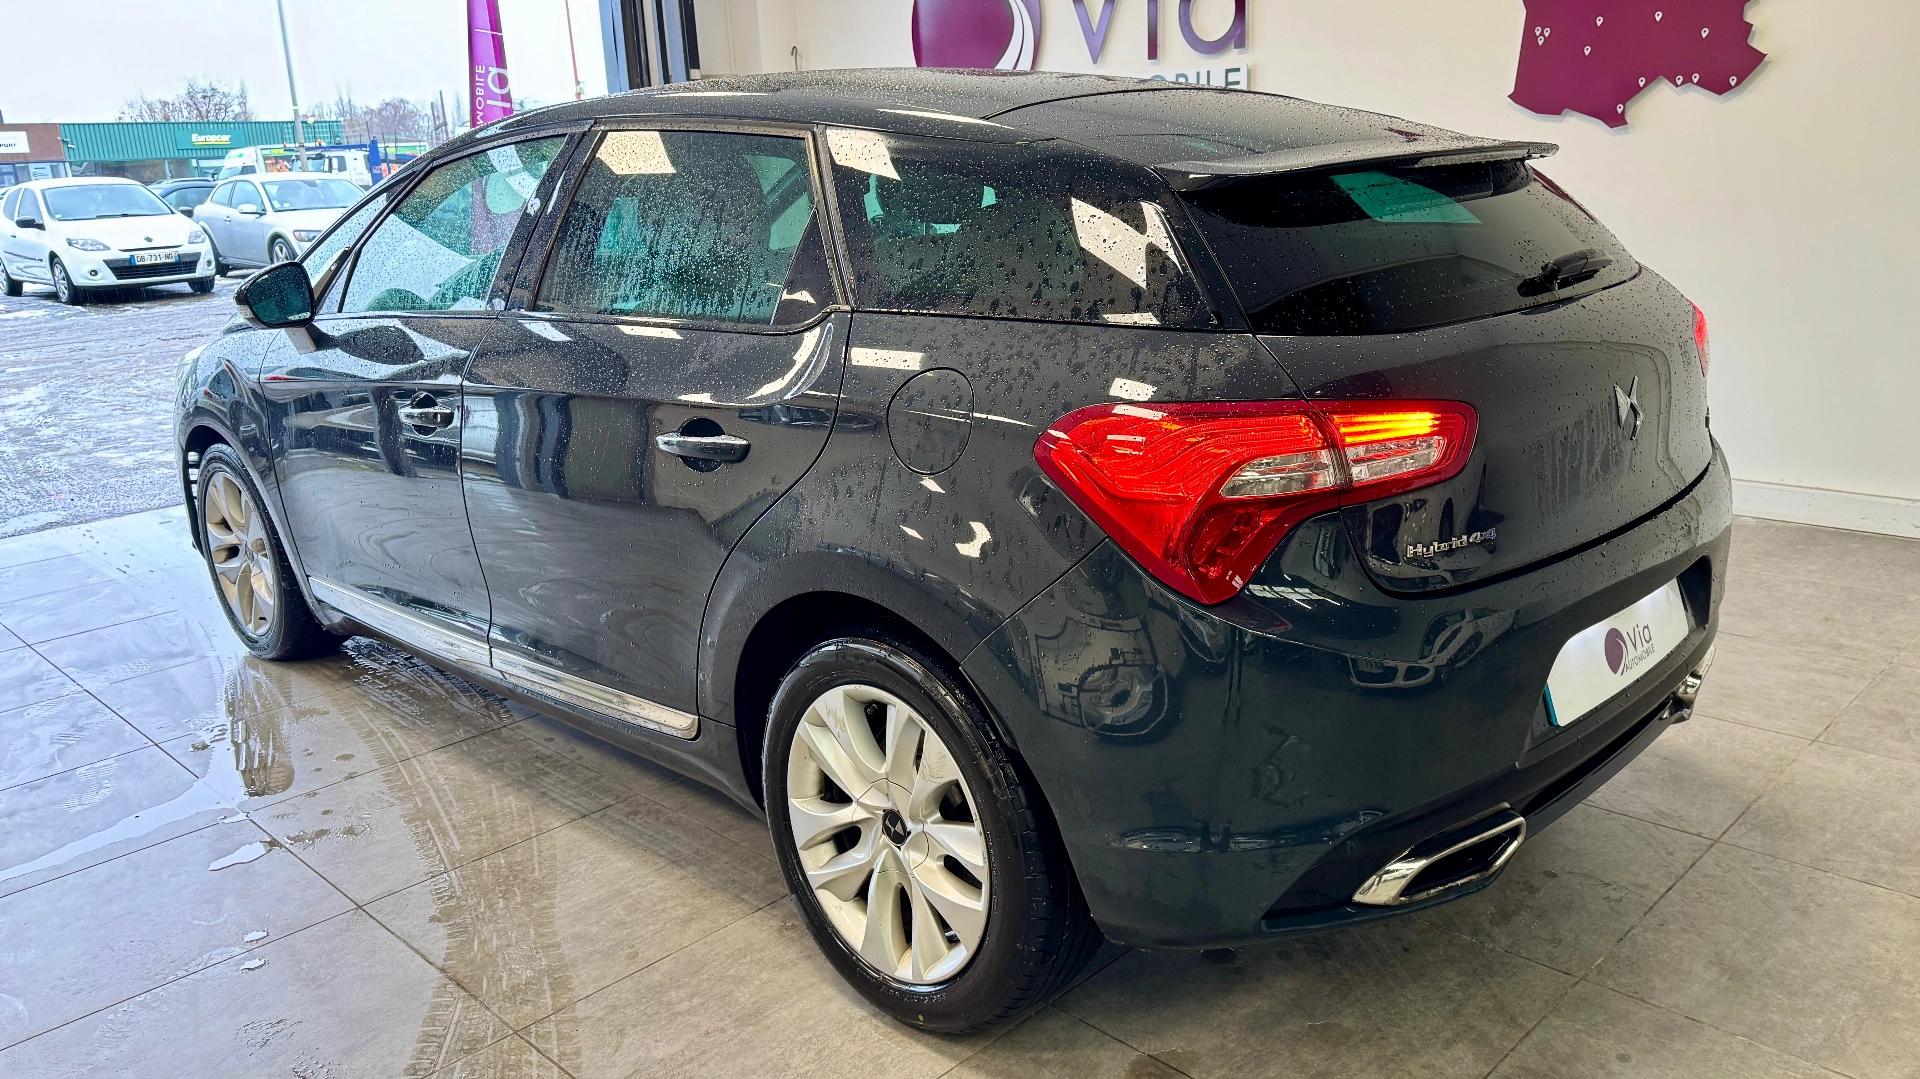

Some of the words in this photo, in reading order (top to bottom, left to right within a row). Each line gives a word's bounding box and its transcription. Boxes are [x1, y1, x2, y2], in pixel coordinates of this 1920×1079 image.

[191, 133, 231, 143] Europcar
[1626, 623, 1652, 652] Via
[1625, 642, 1655, 672] AUTOMOBILE
